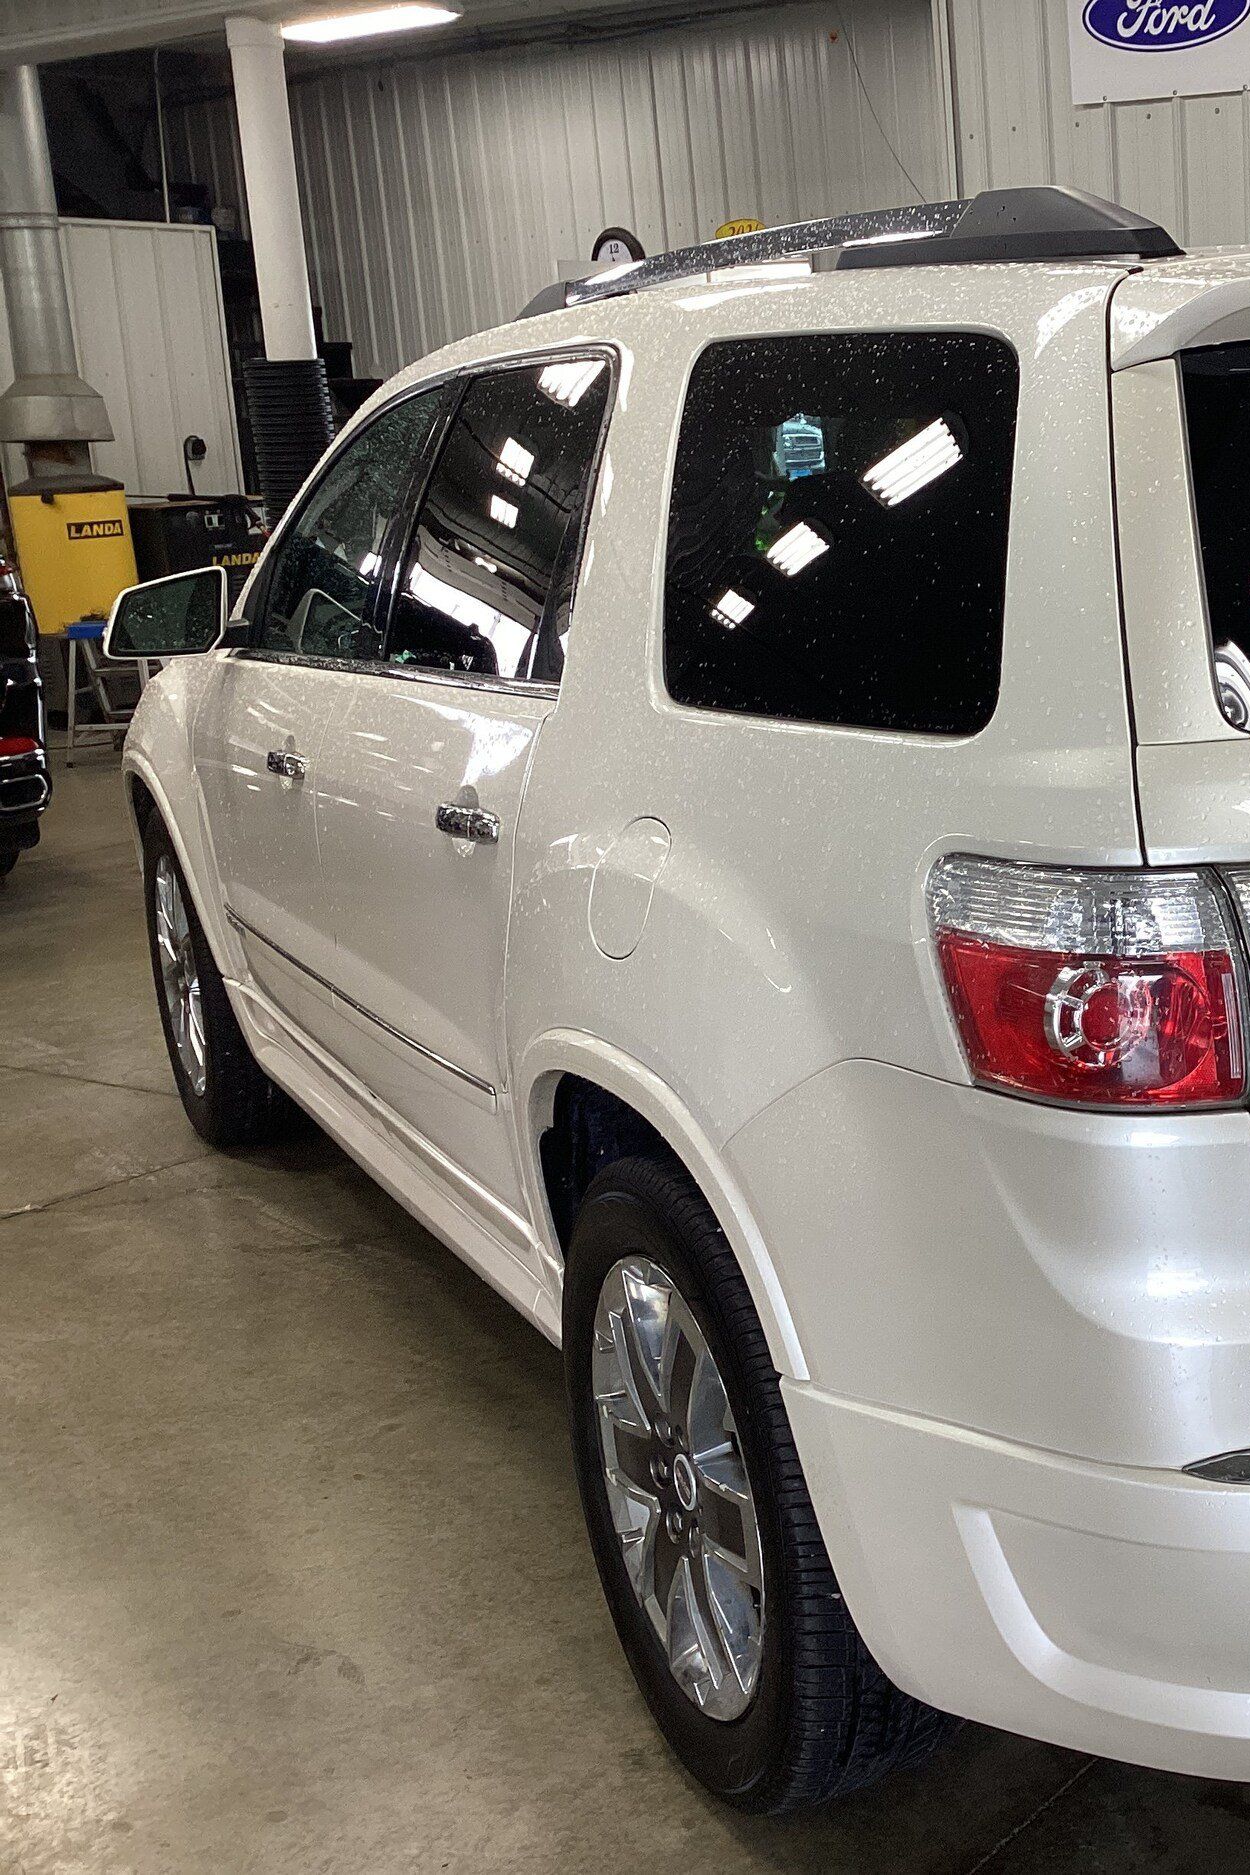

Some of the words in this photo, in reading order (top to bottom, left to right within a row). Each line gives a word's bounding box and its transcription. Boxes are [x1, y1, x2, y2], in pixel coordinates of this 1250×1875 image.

[1116, 0, 1216, 38] Ford
[608, 243, 620, 254] 12
[70, 521, 122, 538] LANDA
